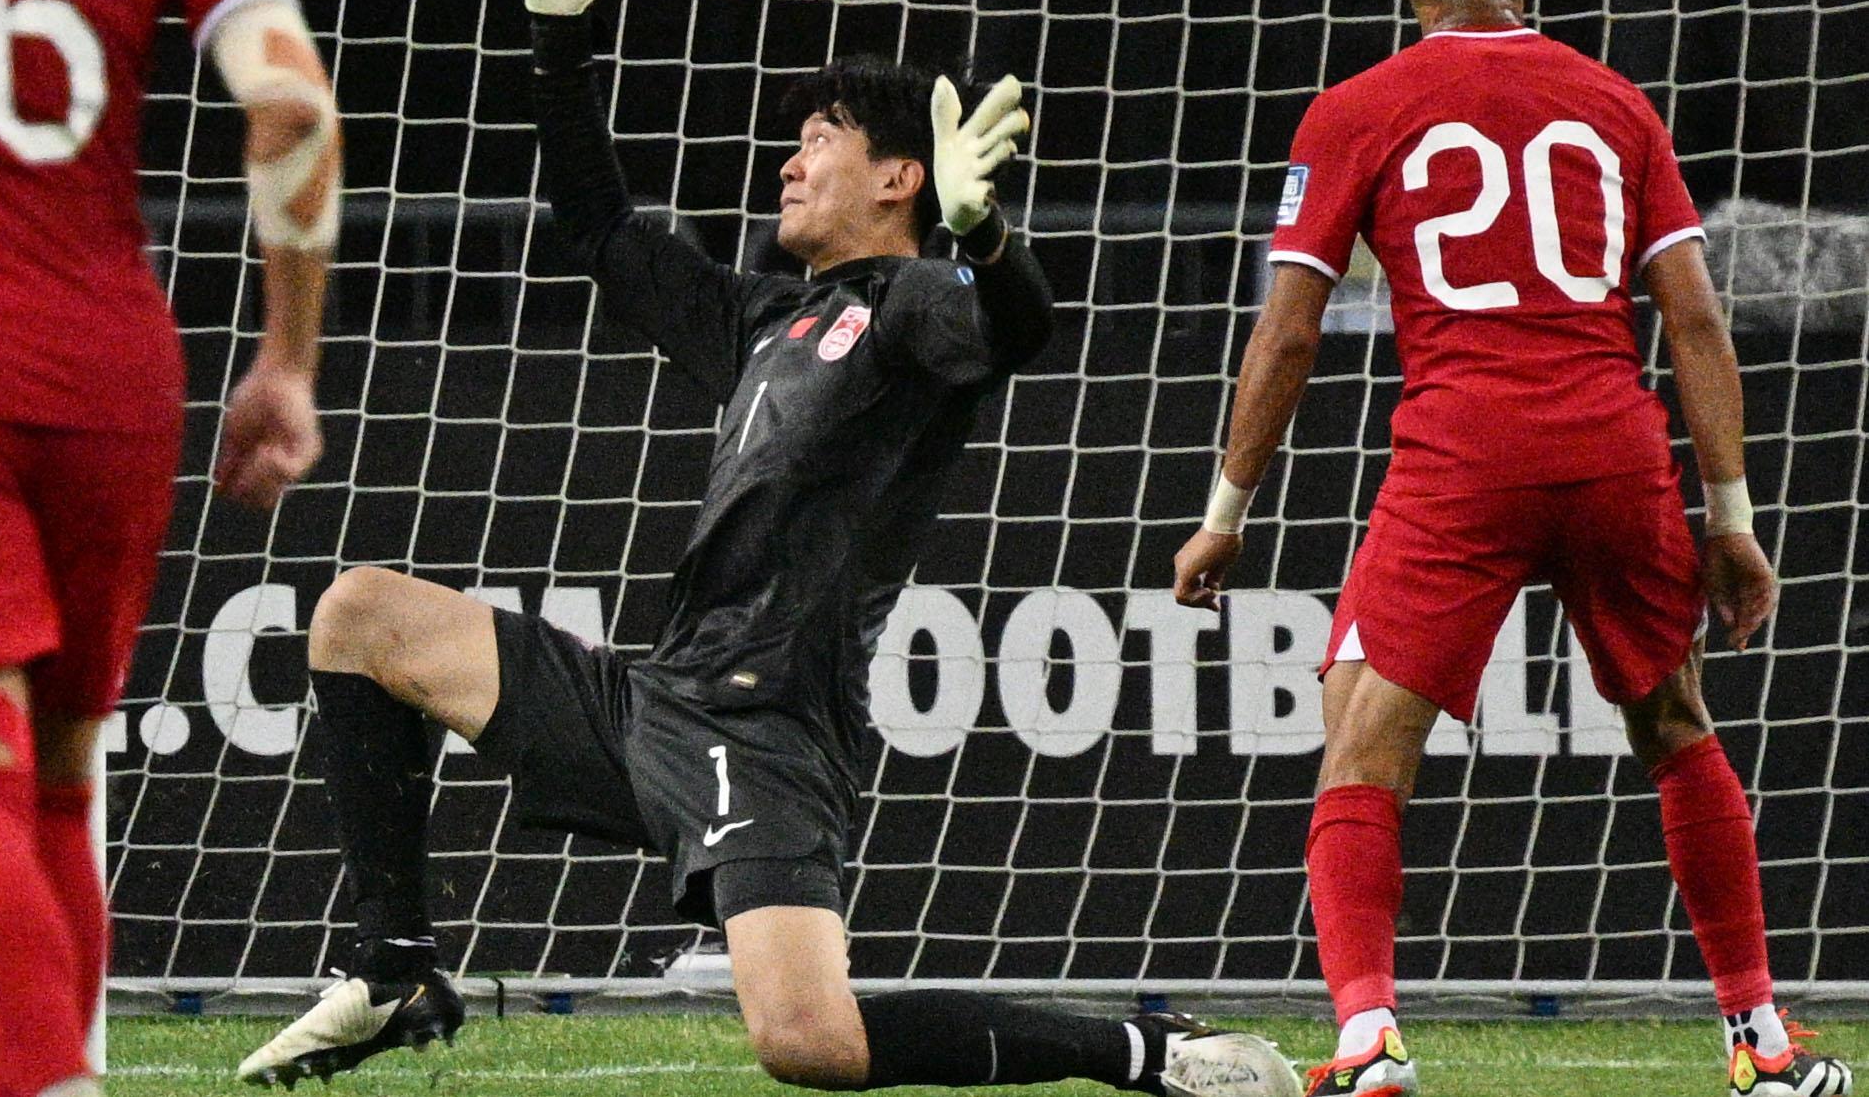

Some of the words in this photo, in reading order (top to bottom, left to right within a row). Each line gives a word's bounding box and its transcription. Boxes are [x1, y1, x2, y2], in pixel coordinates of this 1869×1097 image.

[1402, 120, 1625, 311] 20
[737, 380, 769, 455] 1
[709, 745, 729, 816] 1
